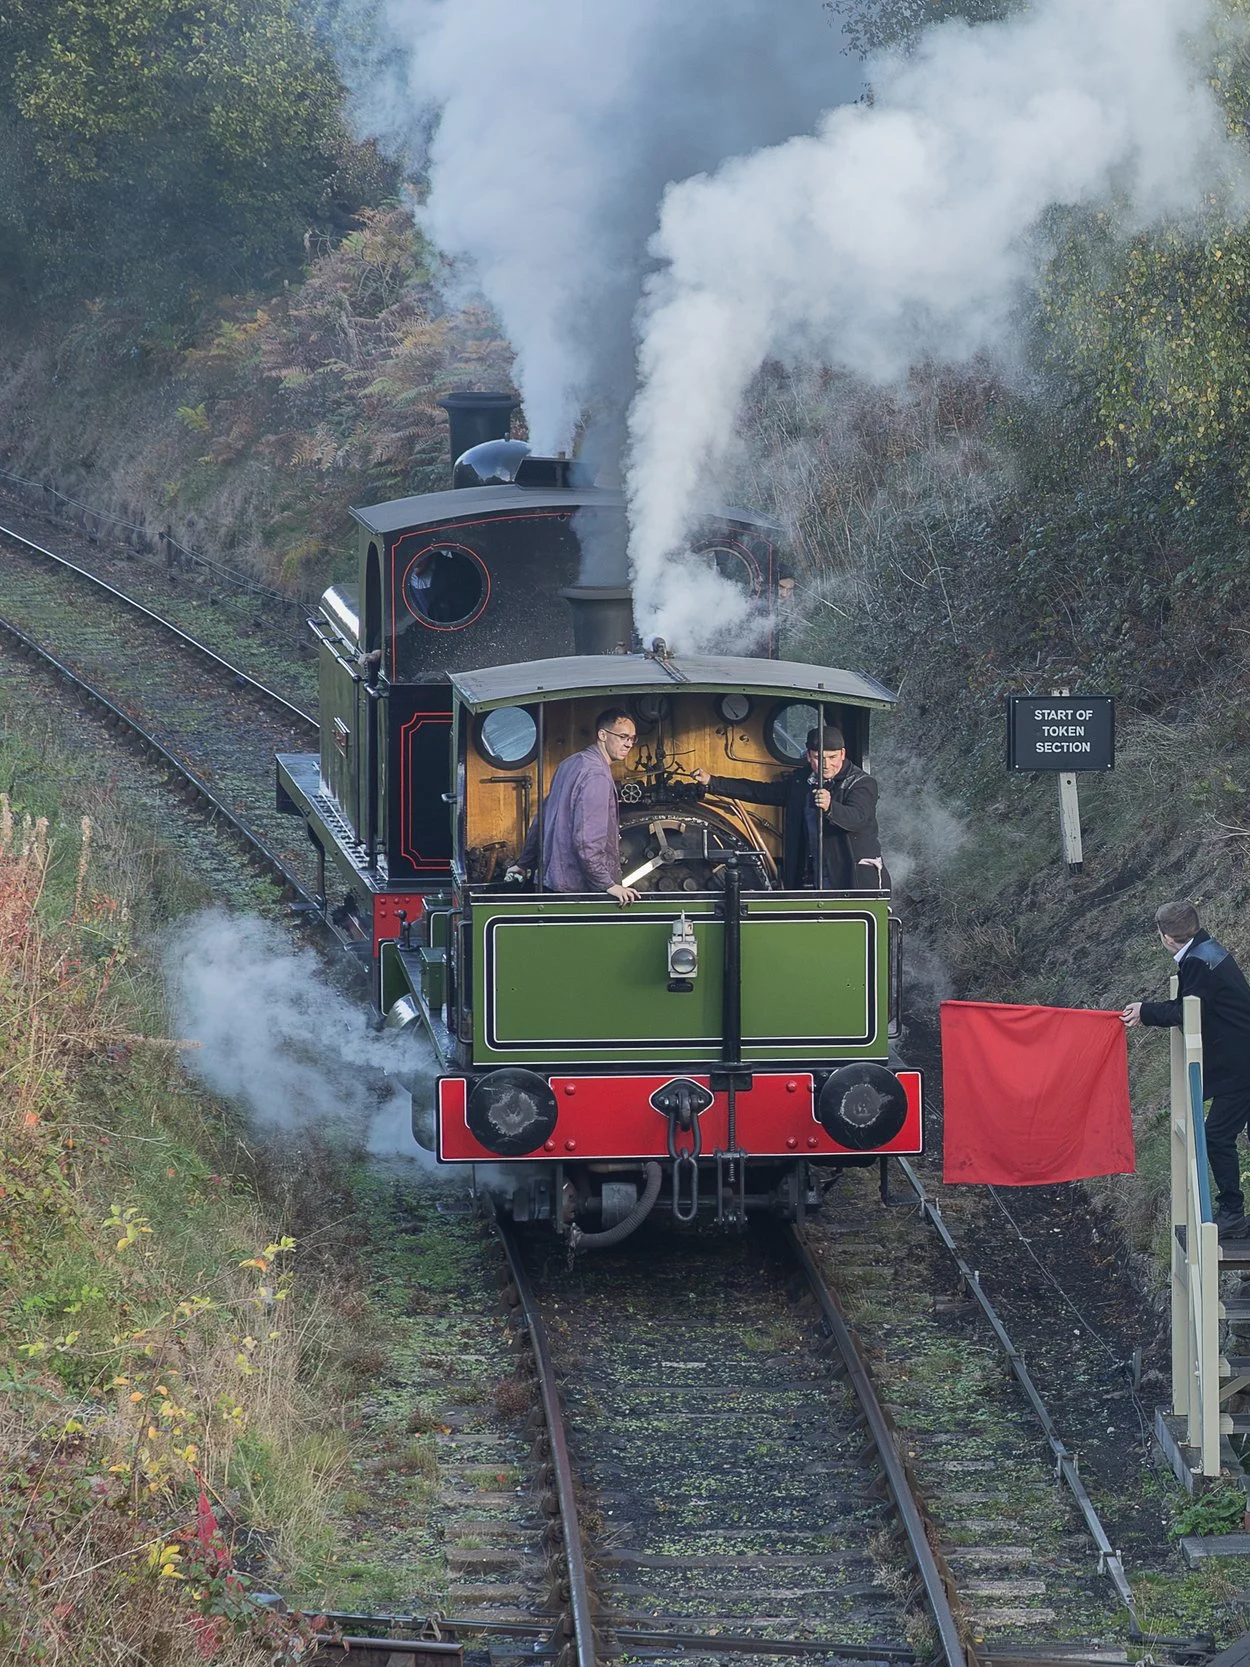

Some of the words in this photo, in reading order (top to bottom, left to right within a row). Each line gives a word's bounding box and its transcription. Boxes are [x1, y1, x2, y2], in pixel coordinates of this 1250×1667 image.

[1034, 710, 1073, 720] START
[1076, 710, 1093, 720] OF
[1042, 726, 1085, 736] TOKEN
[1036, 742, 1091, 752] SECTION
